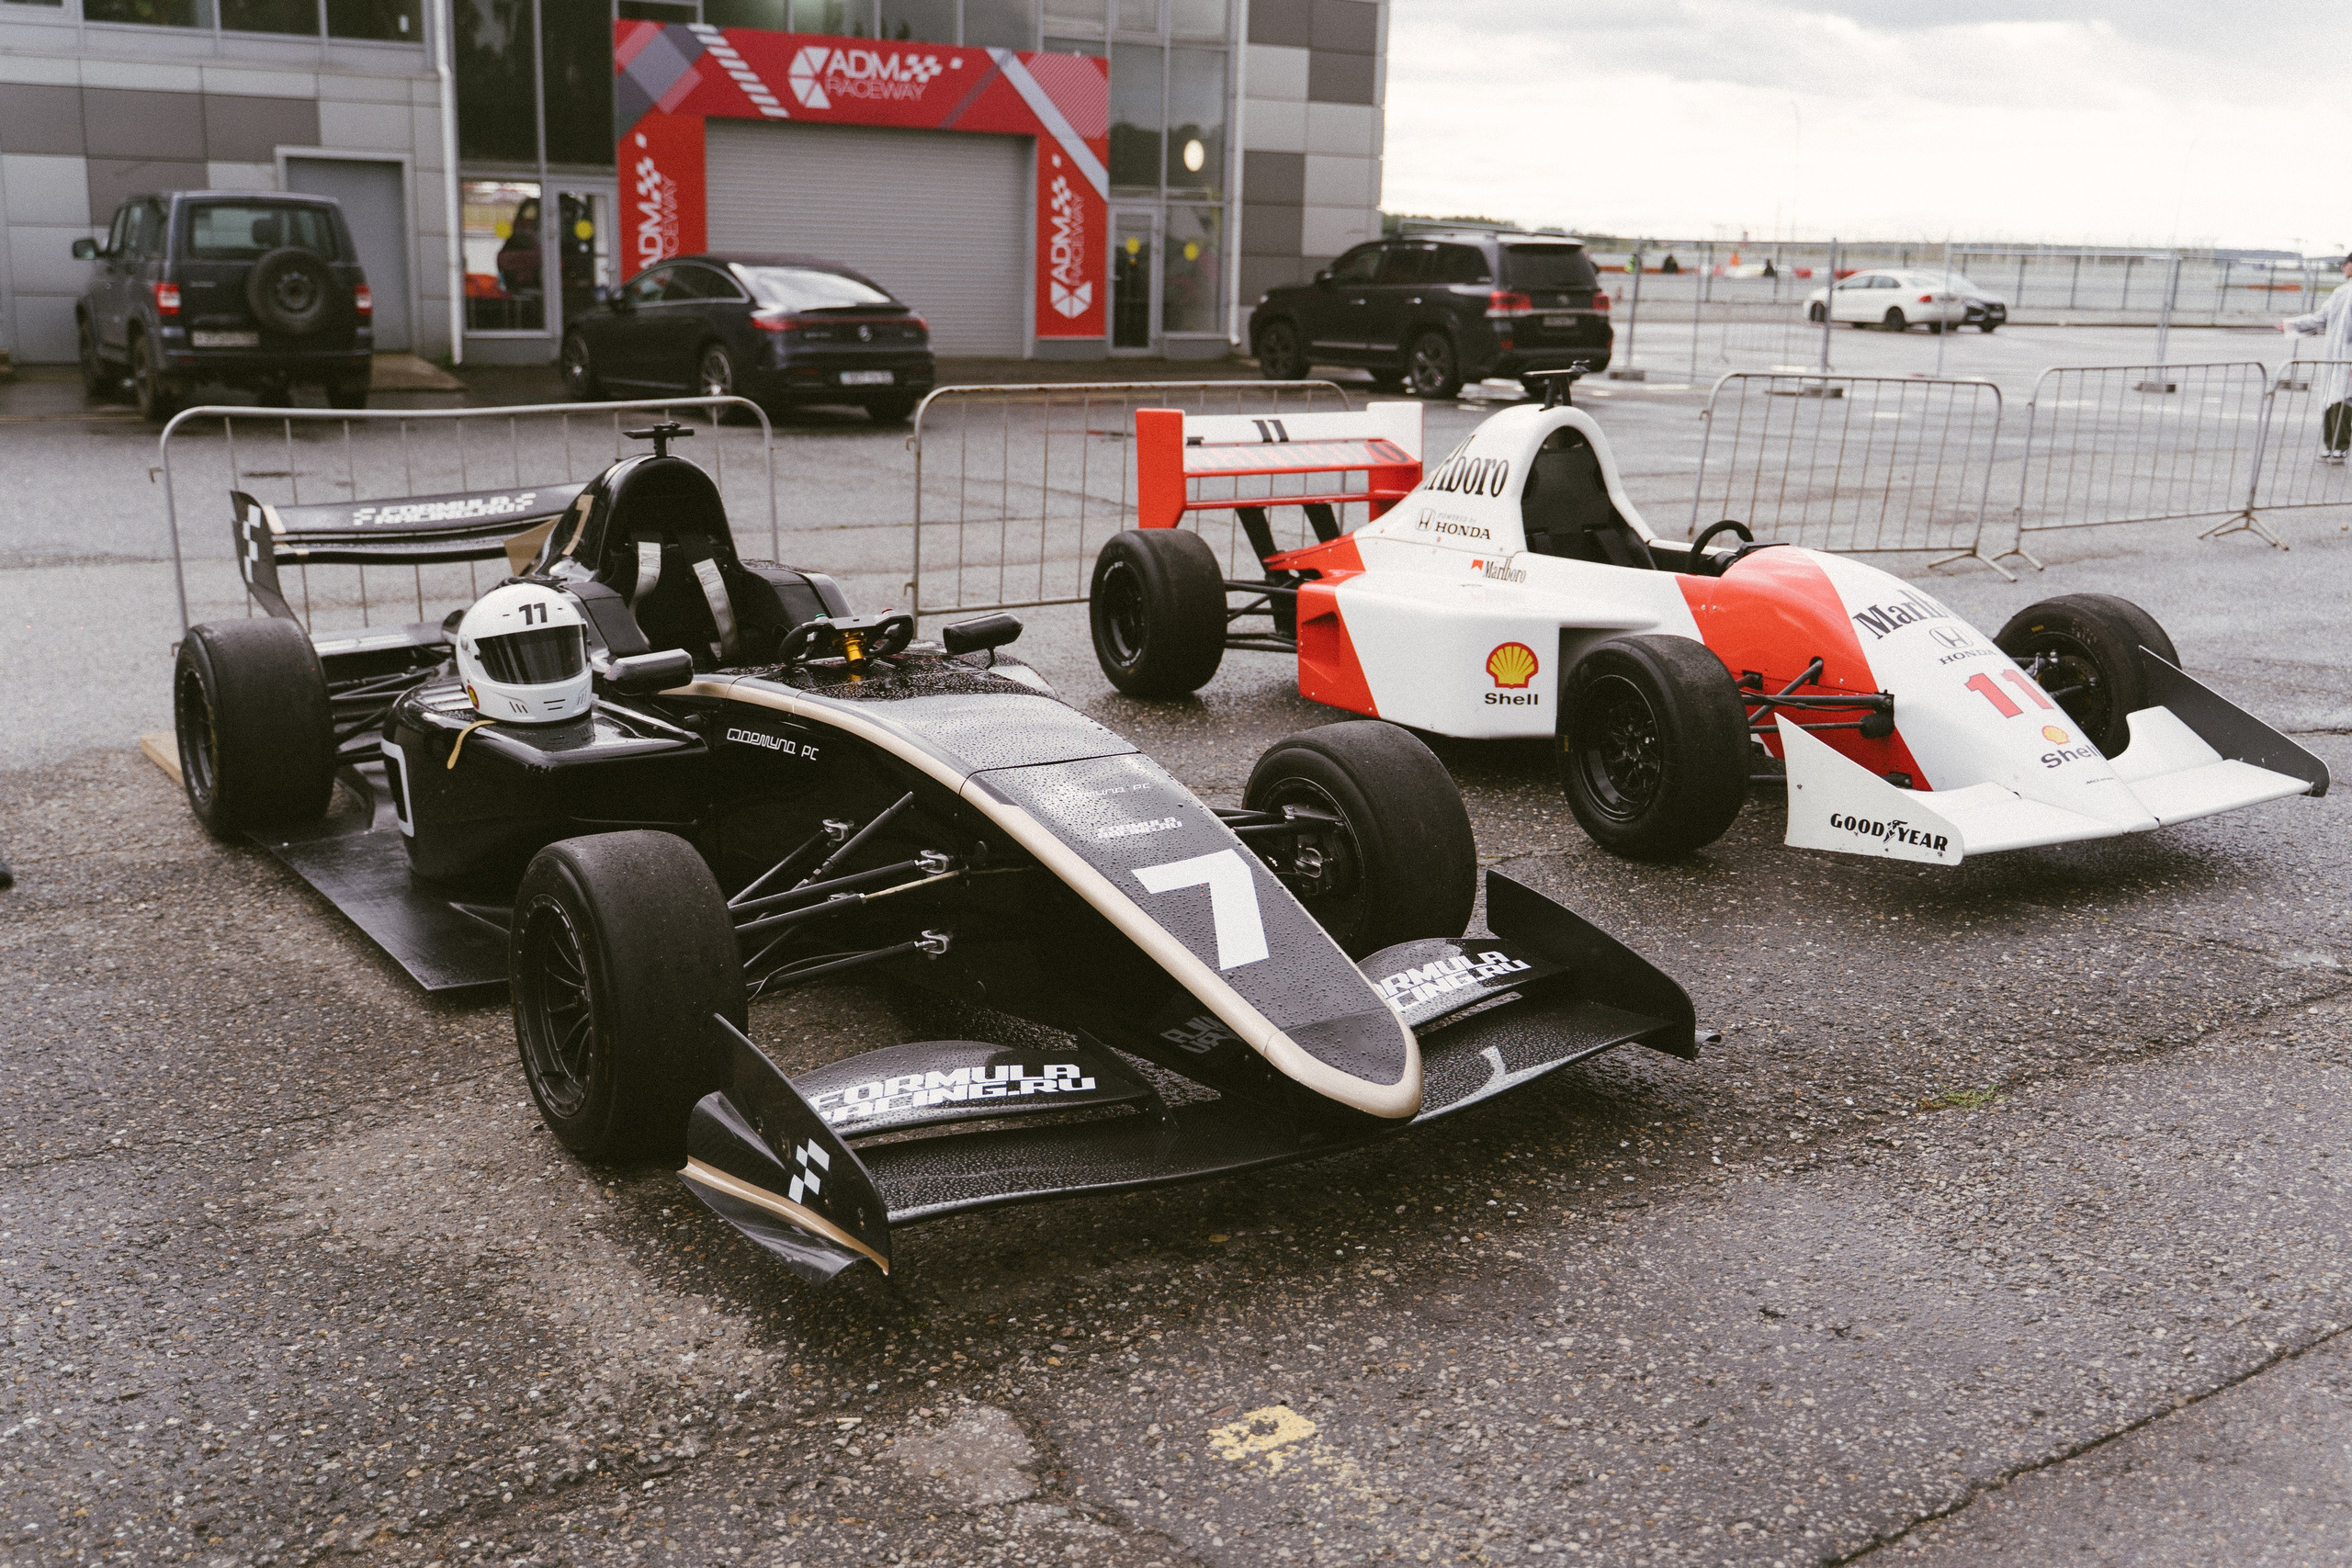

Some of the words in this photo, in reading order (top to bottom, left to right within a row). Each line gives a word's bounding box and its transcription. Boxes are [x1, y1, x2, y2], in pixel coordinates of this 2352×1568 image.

[826, 48, 900, 82] ADM
[825, 75, 927, 101] RACEWAY
[1050, 215, 1071, 285] ADM
[1435, 522, 1491, 540] HONDA
[1484, 558, 1527, 583] Marlboro
[519, 603, 548, 626] 11
[1939, 649, 1997, 666] HONDA
[1484, 693, 1539, 705] Shell
[1963, 669, 2056, 719] 11
[2041, 745, 2103, 769] Shell
[1131, 849, 1270, 971] 7
[807, 1063, 1081, 1112] FORMULA
